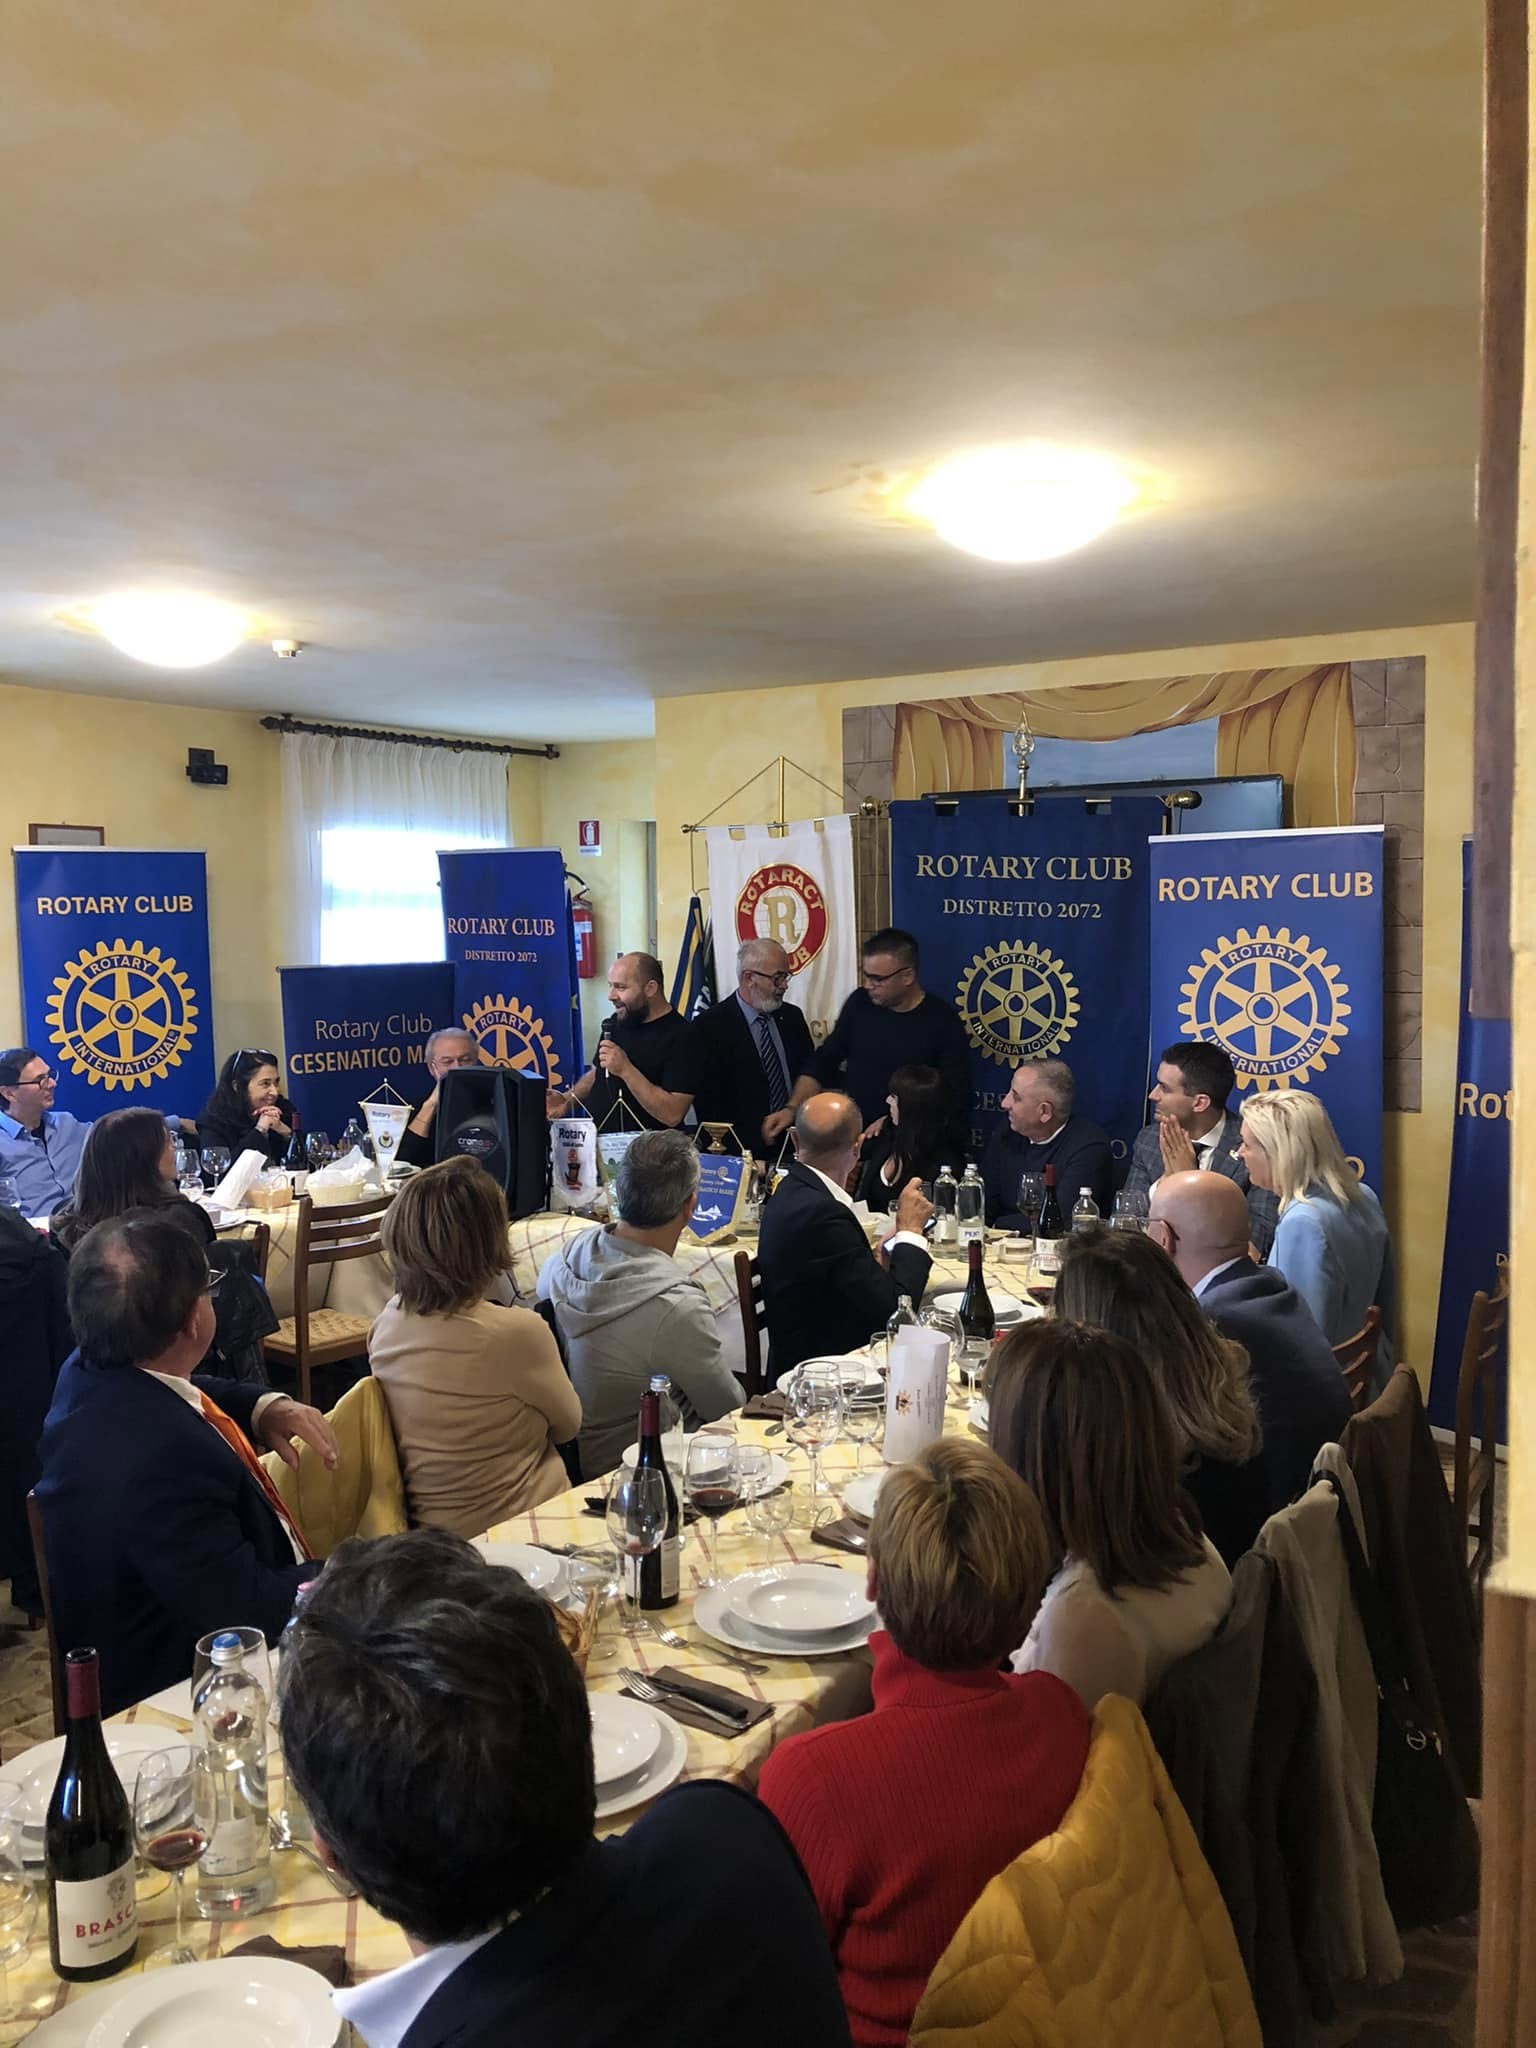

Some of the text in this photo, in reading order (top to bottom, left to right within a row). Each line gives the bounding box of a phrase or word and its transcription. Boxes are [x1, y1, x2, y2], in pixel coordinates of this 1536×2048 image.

[916, 854, 1133, 881] ROTARY CLUB
[740, 868, 823, 916] ROTARACT
[1158, 871, 1374, 902] ROTARY CLUB
[37, 895, 193, 916] ROTARY CLUB
[943, 898, 1102, 919] DISTRETTO 2072
[447, 917, 556, 937] ROTARY CLUB
[763, 895, 800, 945] R
[90, 955, 153, 975] ROTARY
[465, 950, 538, 963] DISTRETTO 2072
[788, 946, 811, 970] UB
[992, 954, 1044, 969] ROTARY
[1228, 944, 1300, 965] ROTARY
[314, 1012, 433, 1042] Rotary Club
[479, 1012, 526, 1031] ROTARY
[972, 1022, 1060, 1055] INTERNATIONAL
[289, 1044, 427, 1075] CESENATICO M
[1206, 1035, 1325, 1075] INERNATIONAL
[1458, 1082, 1514, 1121] Rot
[371, 1110, 391, 1119] Rotary
[558, 1127, 587, 1142] Rotary
[75, 1902, 135, 1938] BRASC
